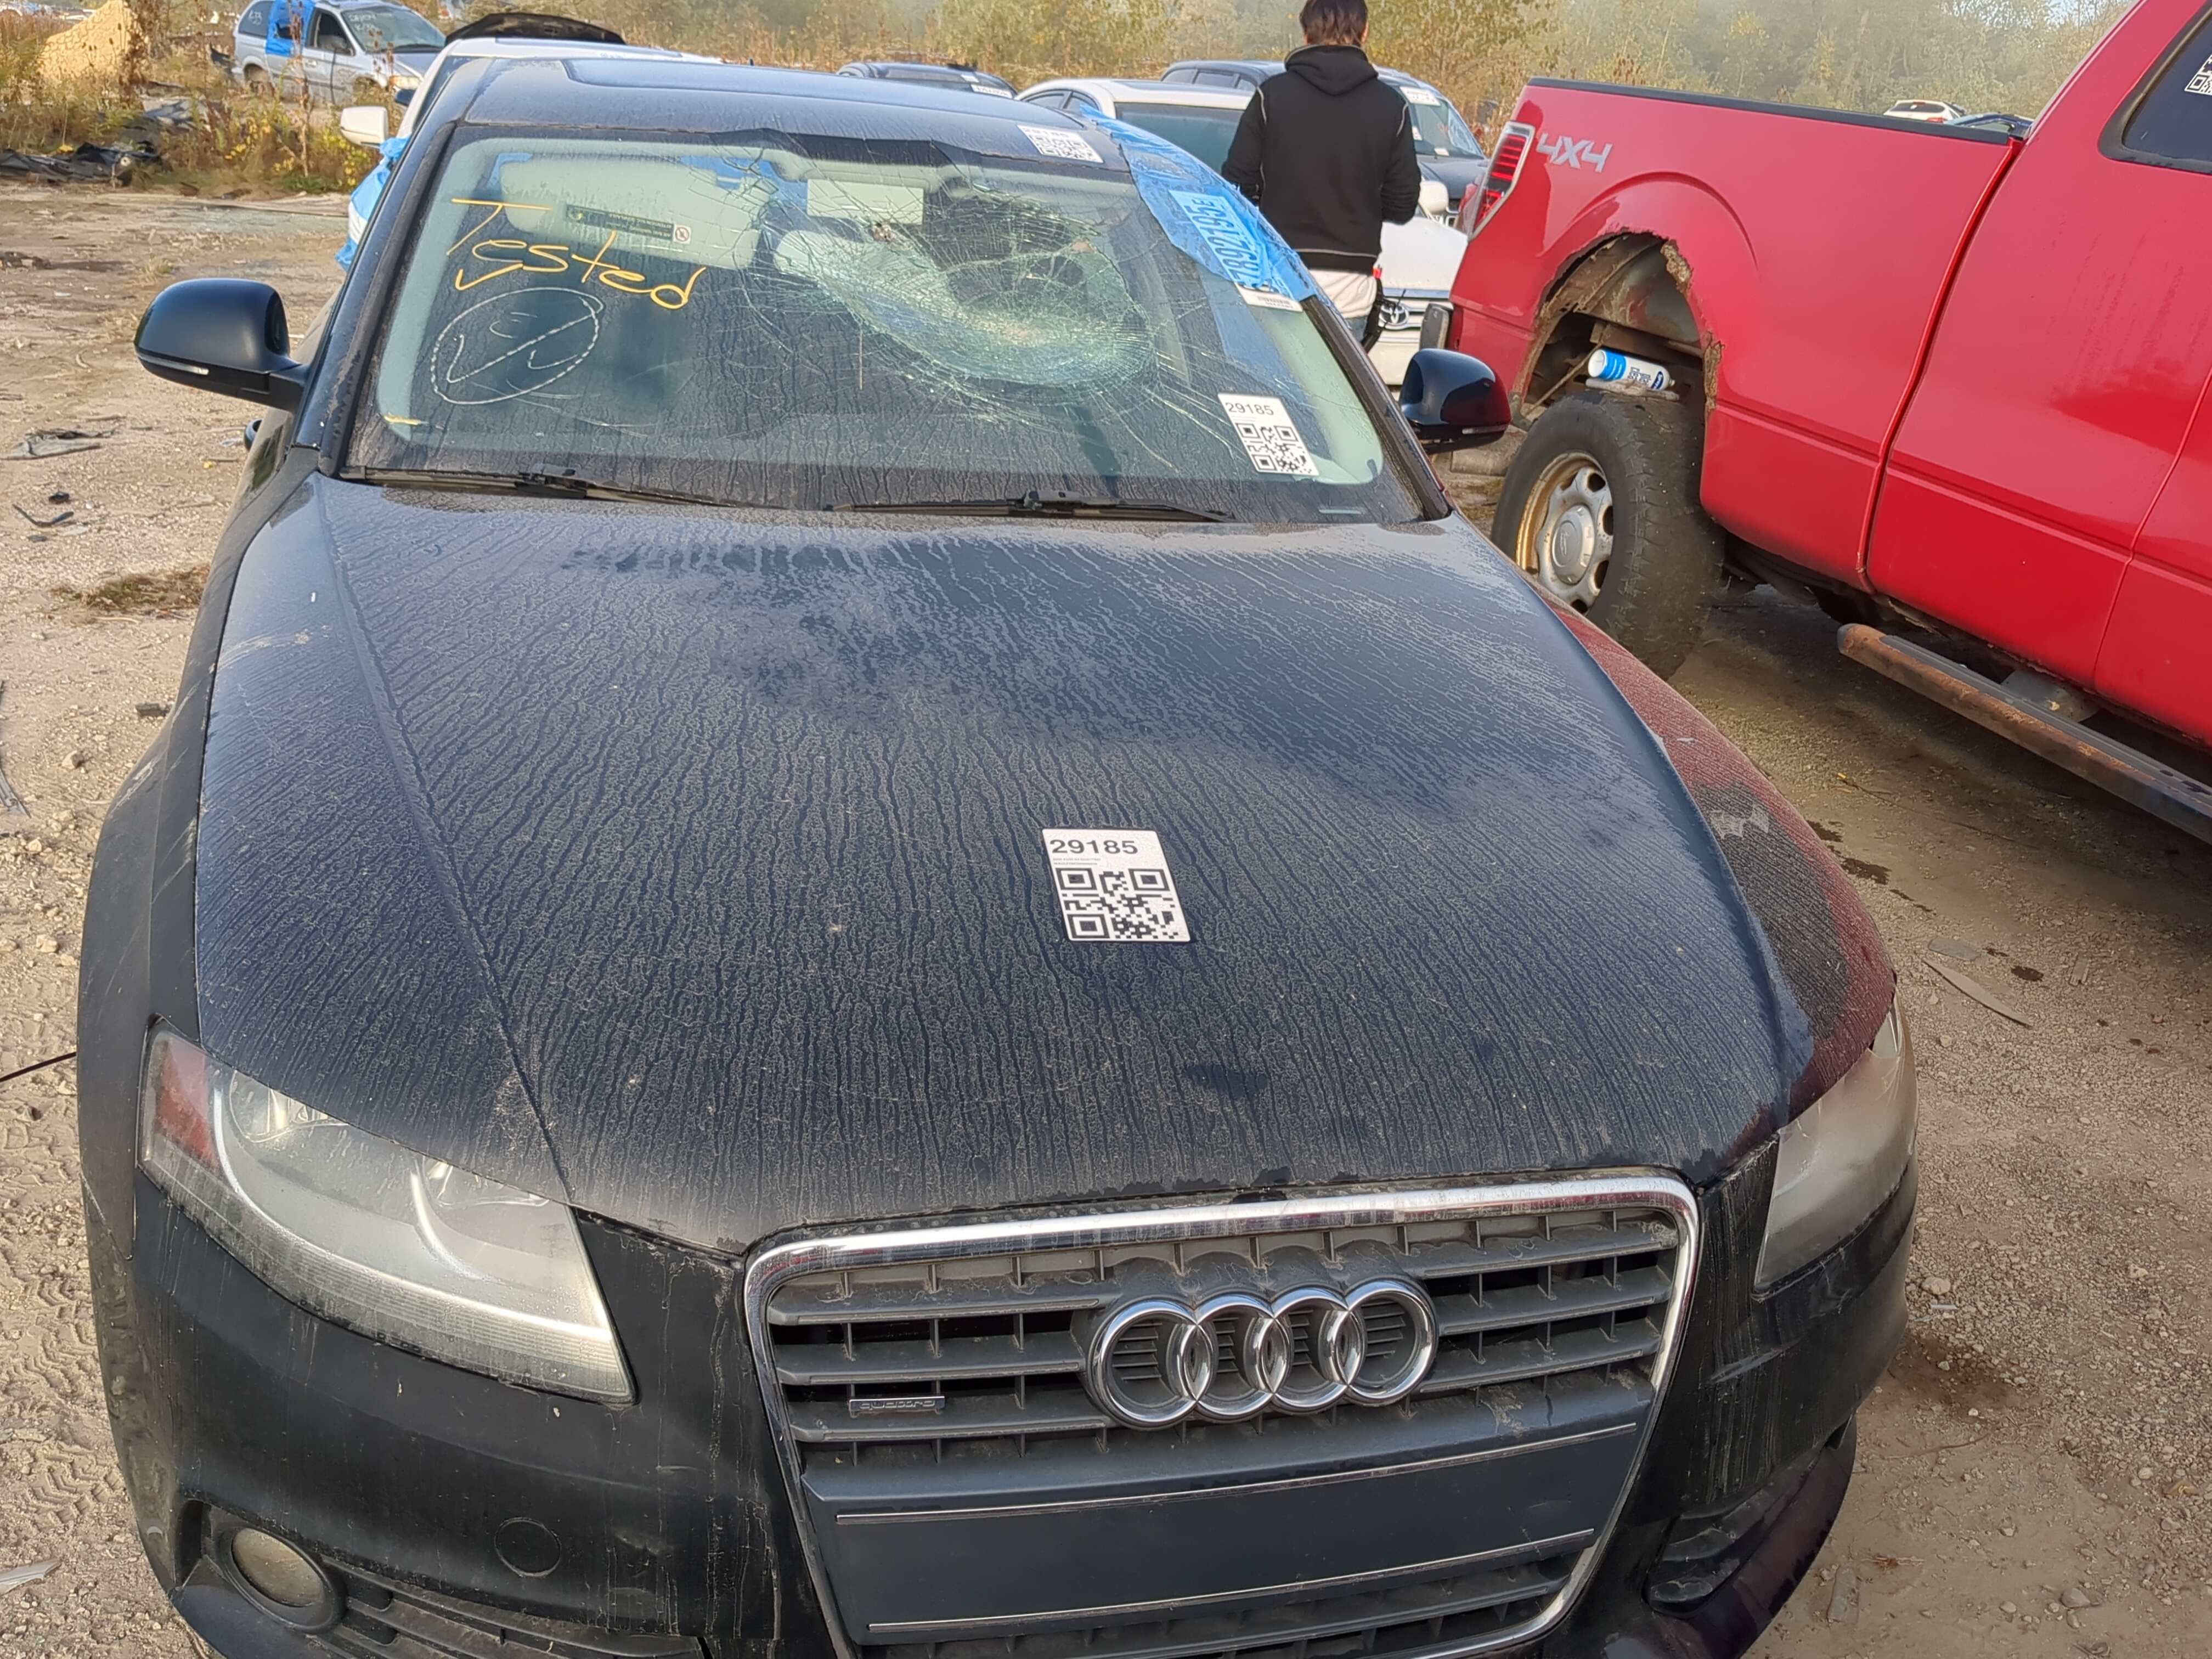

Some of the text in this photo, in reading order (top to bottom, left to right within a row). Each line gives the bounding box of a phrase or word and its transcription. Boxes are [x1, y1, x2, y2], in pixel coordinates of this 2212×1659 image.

[1536, 133, 1613, 173] 4X4
[447, 198, 706, 309] Tested
[1225, 402, 1274, 415] 29185
[1049, 839, 1138, 854] 29185
[860, 1400, 935, 1410] quattro
